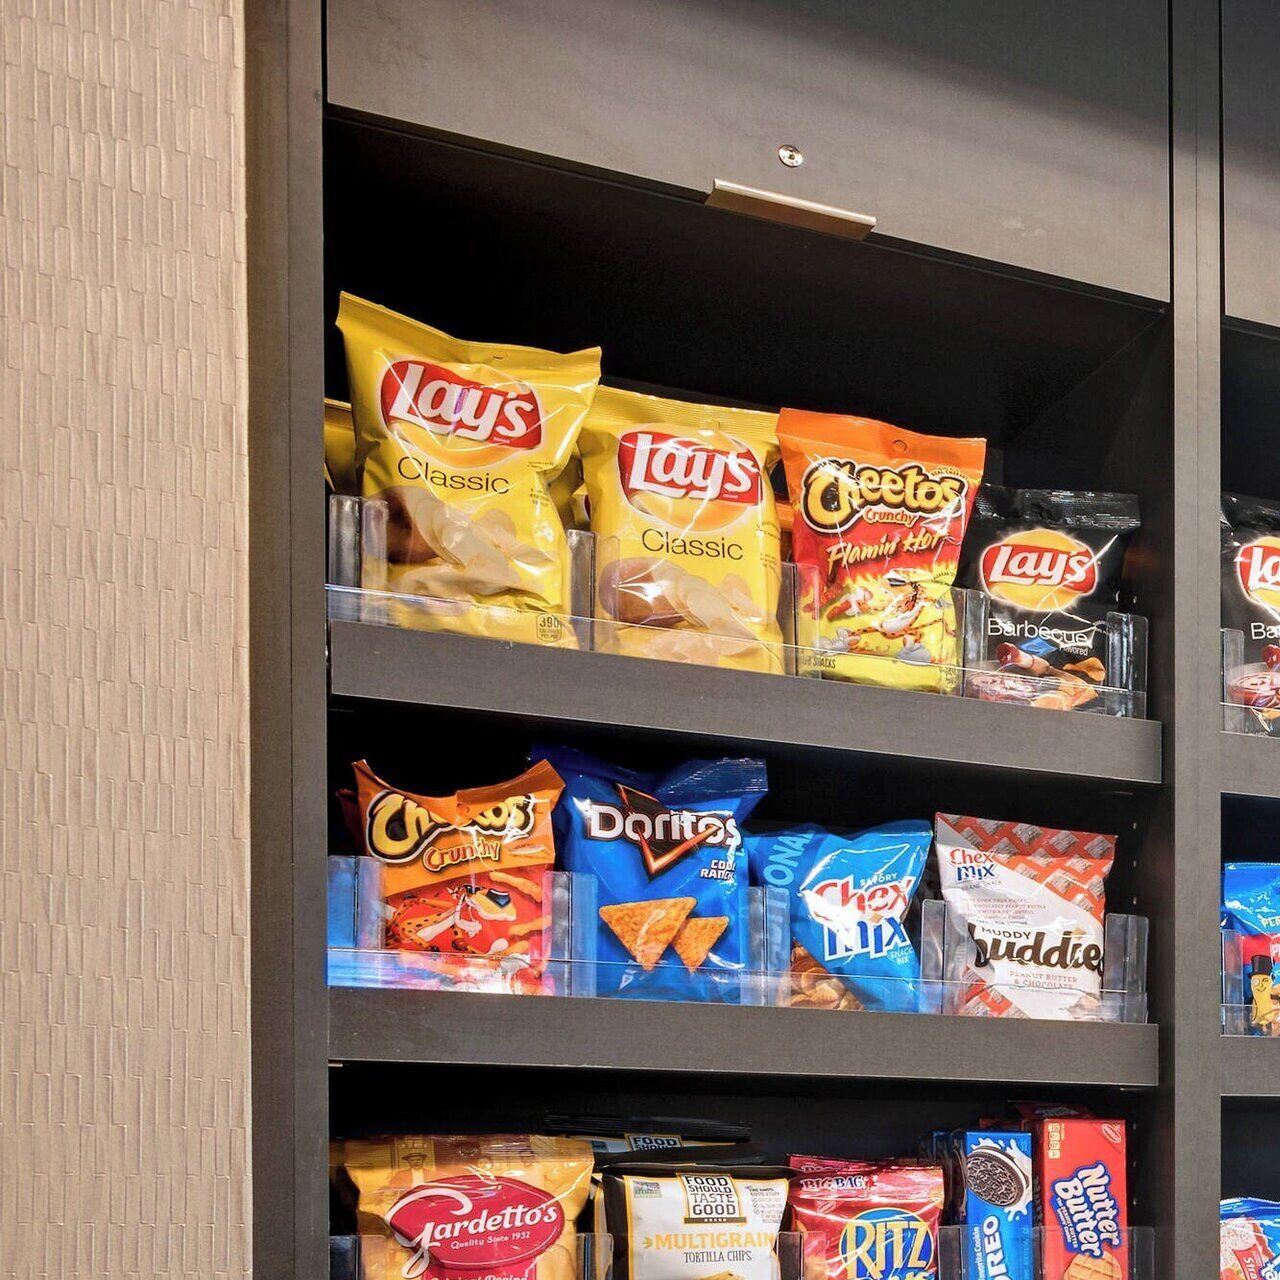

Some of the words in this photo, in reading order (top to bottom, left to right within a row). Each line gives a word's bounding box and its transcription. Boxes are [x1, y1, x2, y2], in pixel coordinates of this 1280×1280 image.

[389, 363, 534, 441] Lay's
[397, 456, 510, 495] Classic
[628, 433, 760, 500] Lay's
[804, 458, 962, 530] Cheetos
[863, 506, 917, 527] Crunchy
[642, 528, 744, 561] Classic
[989, 546, 1089, 587] Lay's
[539, 616, 561, 630] 390
[987, 618, 1089, 645] Barbecue
[590, 805, 742, 847] Doritos
[423, 840, 500, 871] Crunchy
[949, 848, 996, 867] Chex
[956, 863, 996, 883] mix
[812, 875, 917, 914] Chex
[981, 926, 1031, 940] MUDDY
[1022, 978, 1074, 989] CHOCOLATE
[1046, 974, 1078, 983] BUTTER
[633, 1136, 678, 1147] FOOD
[686, 1176, 728, 1187] FOOD
[689, 1185, 732, 1194] SHOULD
[835, 1175, 864, 1190] BAG
[691, 1193, 736, 1204] TASTE
[1076, 1163, 1122, 1247] Nutter
[693, 1204, 737, 1216] GOOD
[1054, 1177, 1105, 1258] Butter
[451, 1238, 484, 1250] Quality
[511, 1231, 531, 1241] 1932
[655, 1231, 774, 1250] MULTIGRAIN
[844, 1219, 934, 1280] RITZ
[684, 1251, 726, 1264] TORTILLA
[727, 1250, 753, 1262] CHIPS
